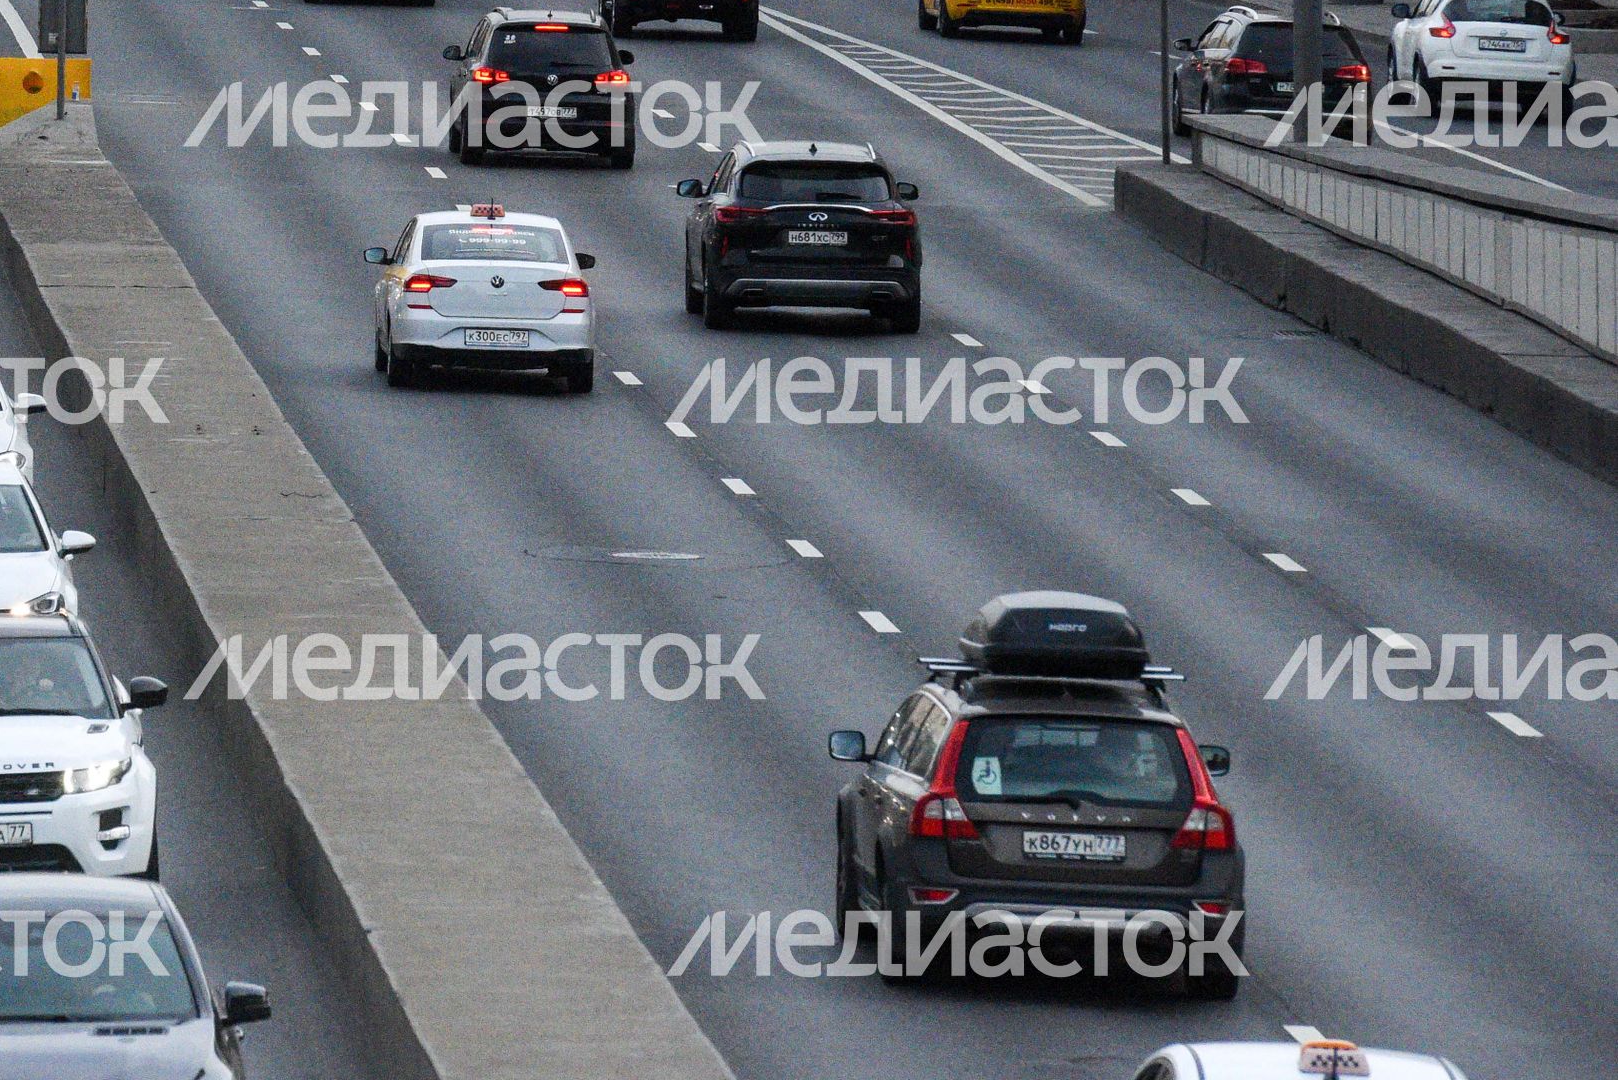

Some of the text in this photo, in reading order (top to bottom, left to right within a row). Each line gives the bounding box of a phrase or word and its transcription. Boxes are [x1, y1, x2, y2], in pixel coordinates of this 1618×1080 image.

[790, 233, 830, 244] Н681ХС
[468, 331, 526, 342] К300ЕС 797
[10, 825, 25, 838] 77
[1028, 835, 1120, 852] К867УН 777
